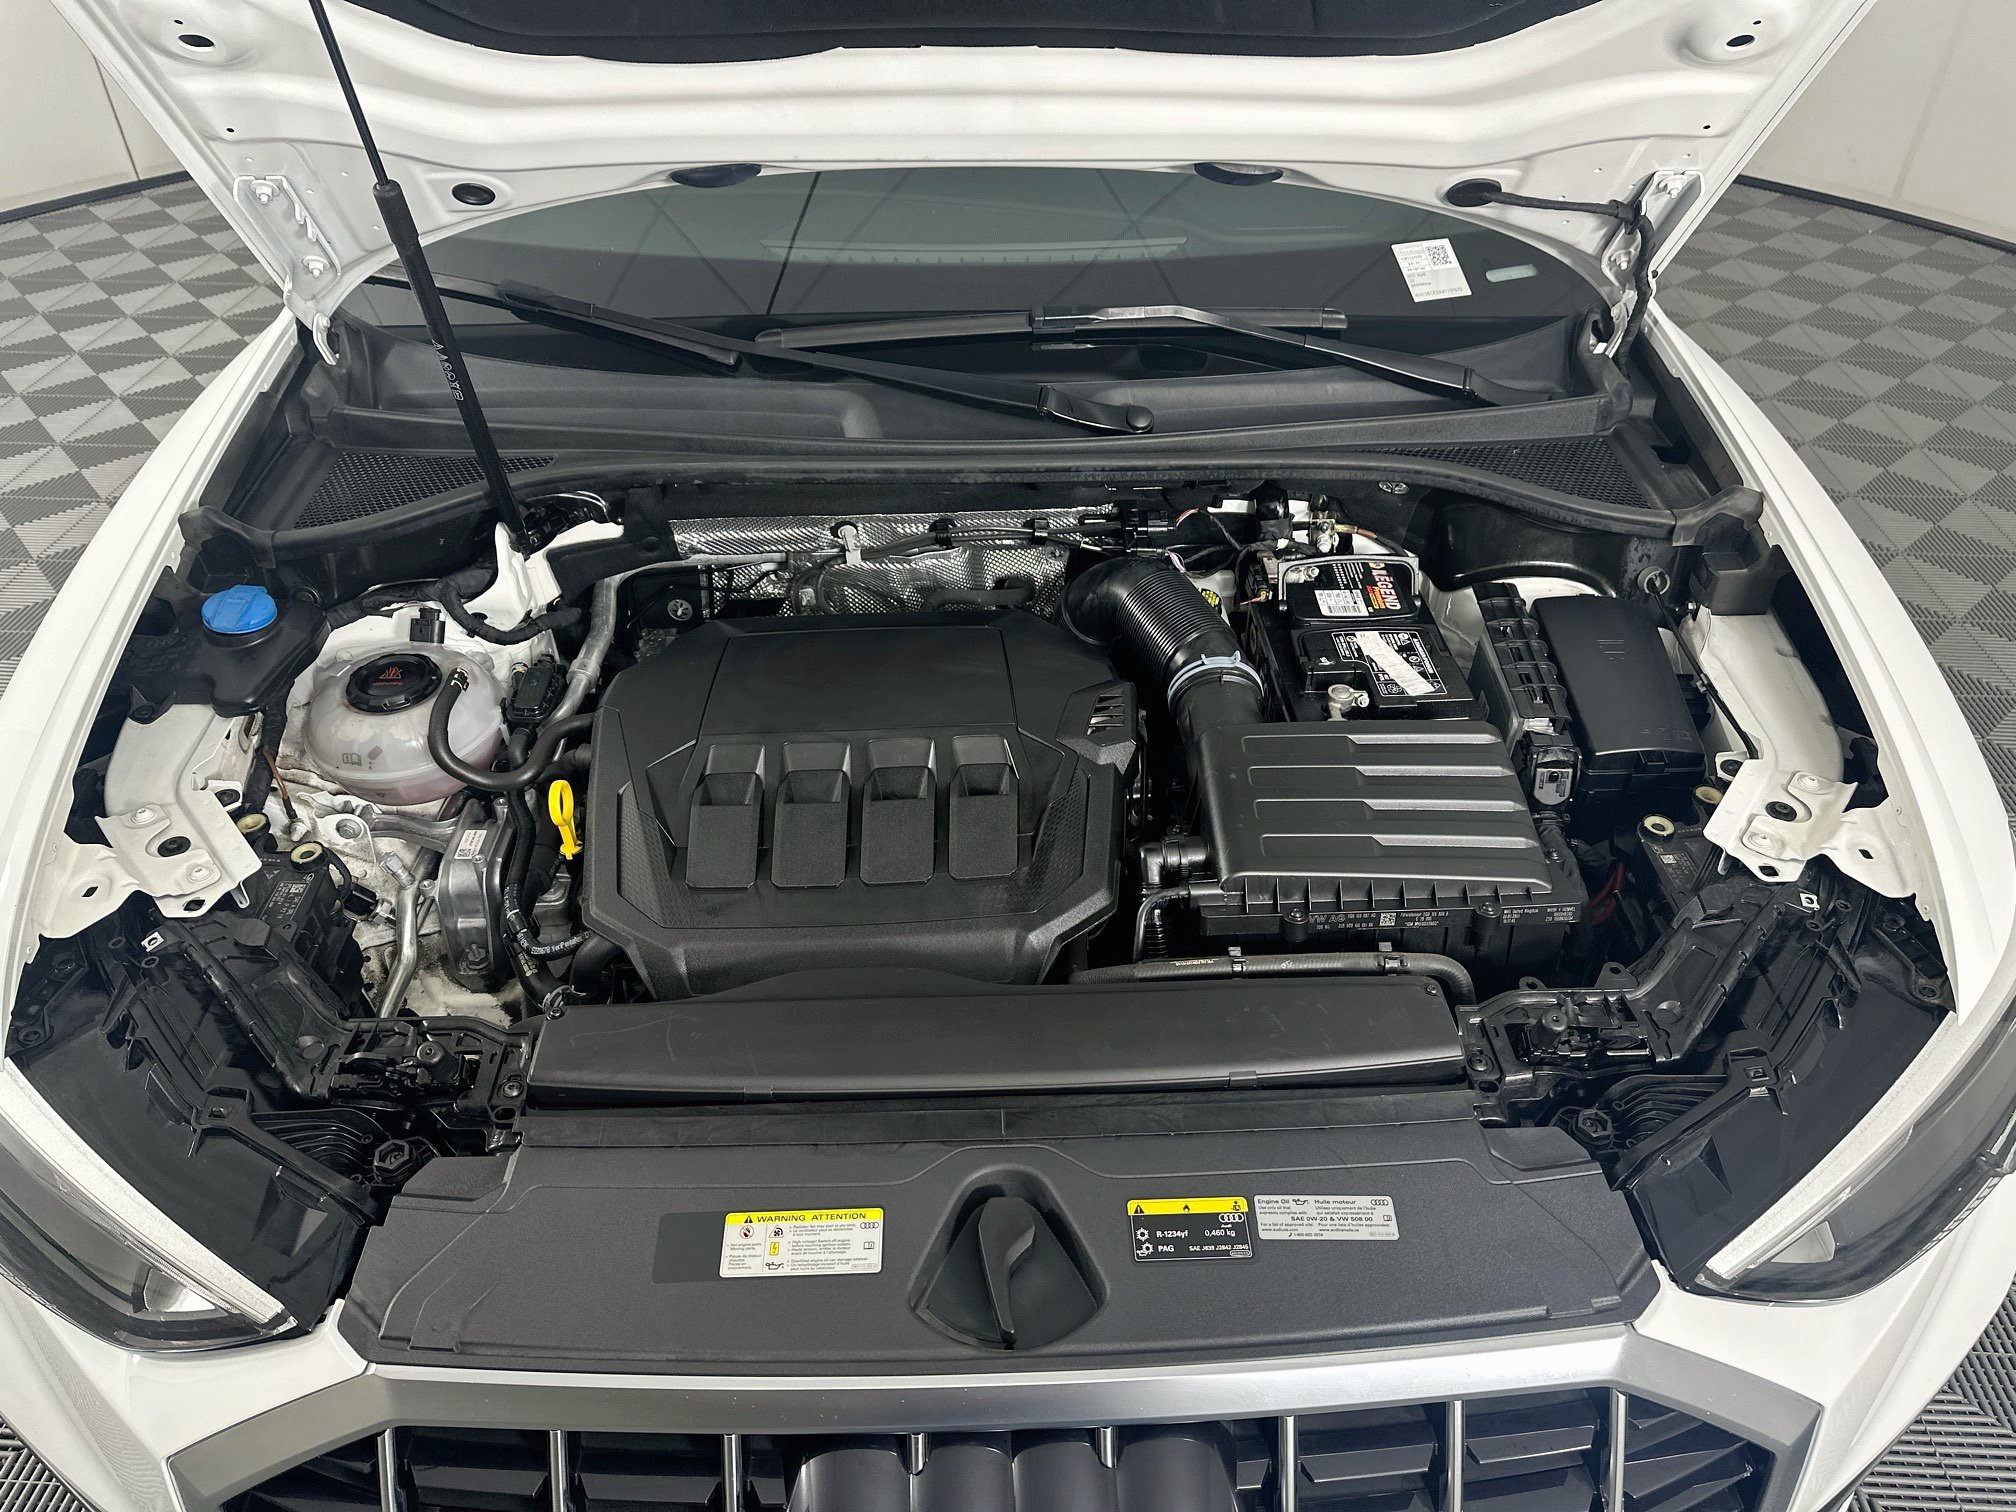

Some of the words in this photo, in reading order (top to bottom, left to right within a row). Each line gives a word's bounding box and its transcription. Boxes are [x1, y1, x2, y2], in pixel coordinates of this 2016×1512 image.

[1308, 915, 1327, 923] VW
[757, 1215, 806, 1223] WARNING
[812, 1213, 867, 1221] ATTENTION
[1156, 1230, 1188, 1238] R-1234yf
[1204, 1229, 1224, 1237] 0,460
[1226, 1229, 1236, 1237] kg
